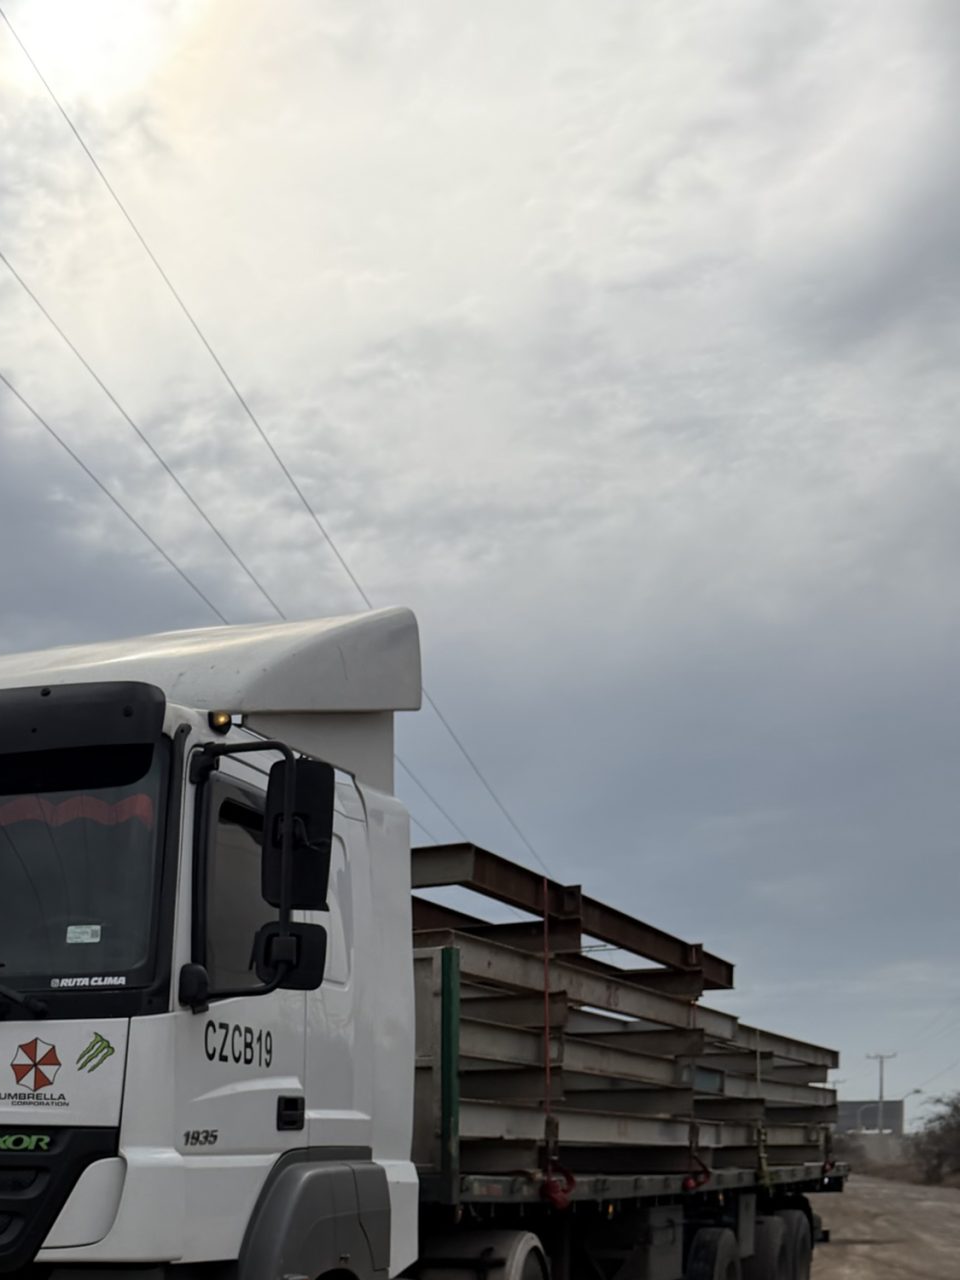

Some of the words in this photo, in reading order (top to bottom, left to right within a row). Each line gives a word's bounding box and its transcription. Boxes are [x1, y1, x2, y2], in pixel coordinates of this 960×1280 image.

[60, 977, 90, 987] RUTA
[90, 976, 126, 986] CLIMA
[204, 1019, 273, 1068] CZCB19
[183, 1129, 218, 1146] 1935
